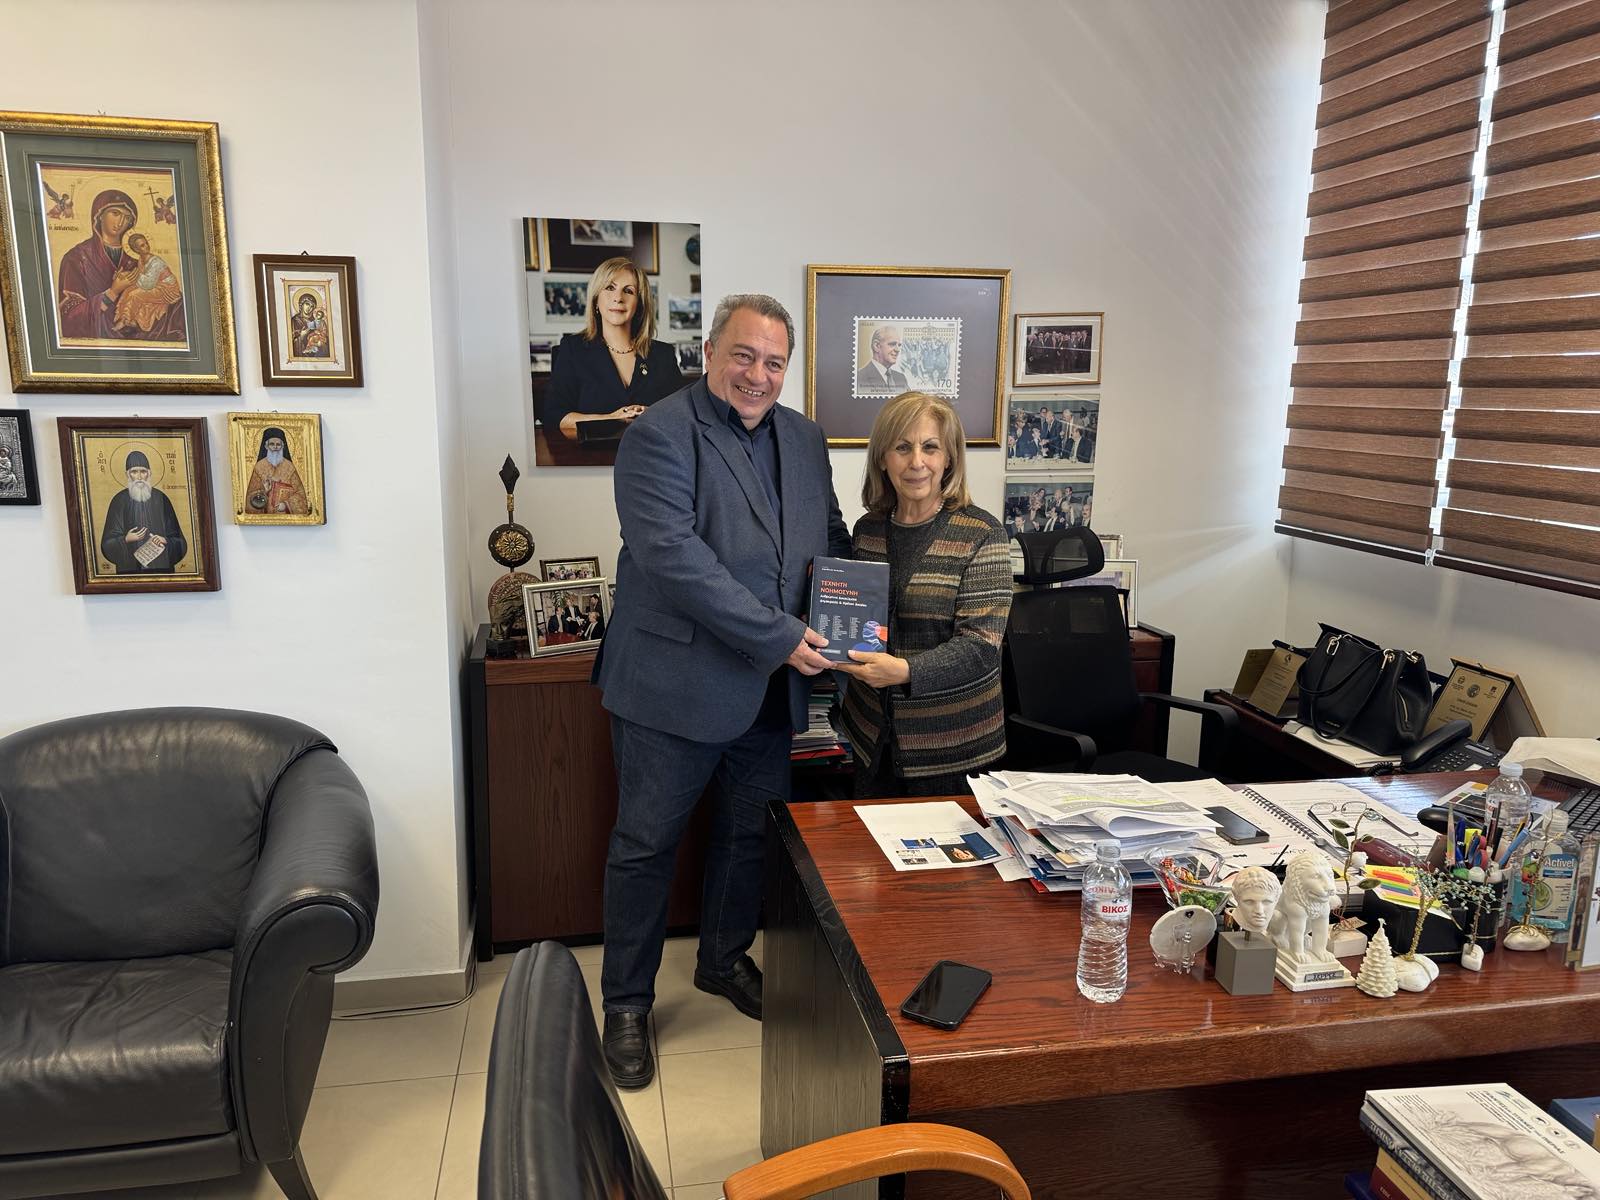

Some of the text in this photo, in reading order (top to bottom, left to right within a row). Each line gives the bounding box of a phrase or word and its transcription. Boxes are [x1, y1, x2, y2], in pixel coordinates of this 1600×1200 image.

[937, 379, 952, 388] 170
[820, 587, 858, 596] ΝΟΗΜΟΣΥΝΗ
[1101, 905, 1128, 914] ΒΙΚΟΣ
